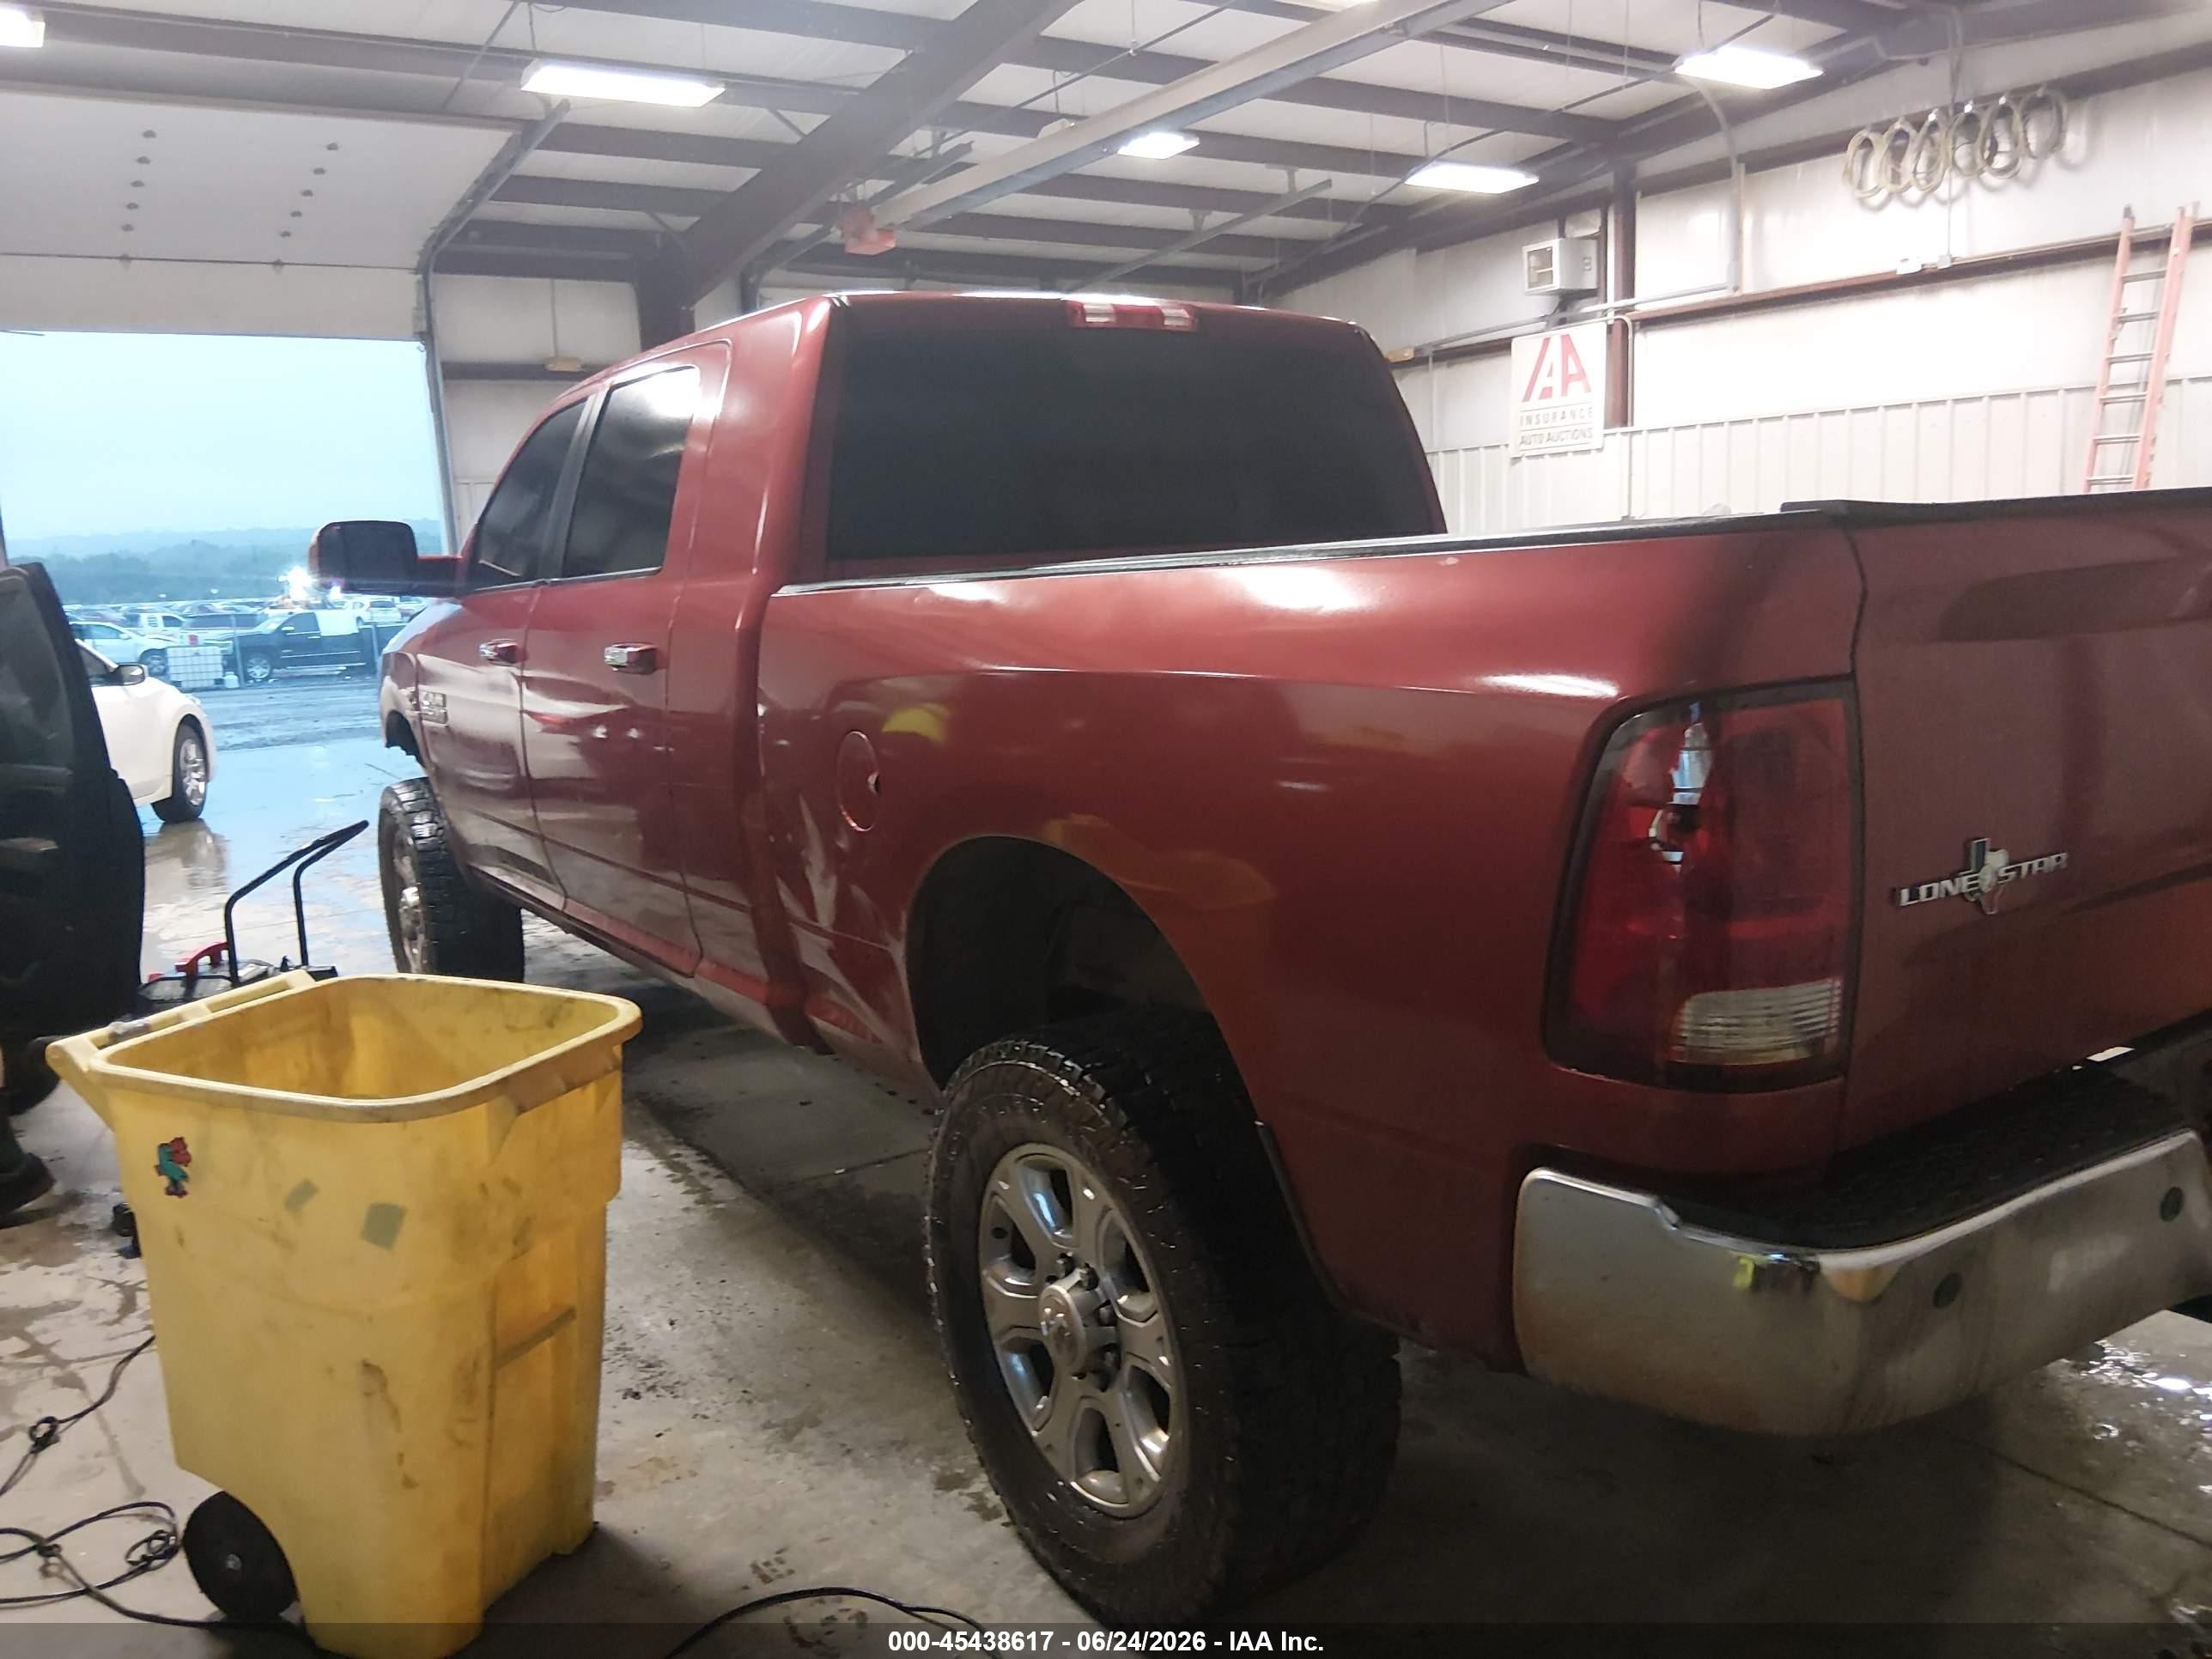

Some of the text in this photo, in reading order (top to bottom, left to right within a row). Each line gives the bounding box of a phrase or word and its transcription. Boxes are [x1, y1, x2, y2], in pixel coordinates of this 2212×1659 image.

[1519, 406, 1594, 427] INSURANCE
[1519, 427, 1594, 447] AUTO AUCTIONS
[1899, 852, 2068, 906] LONE STAR
